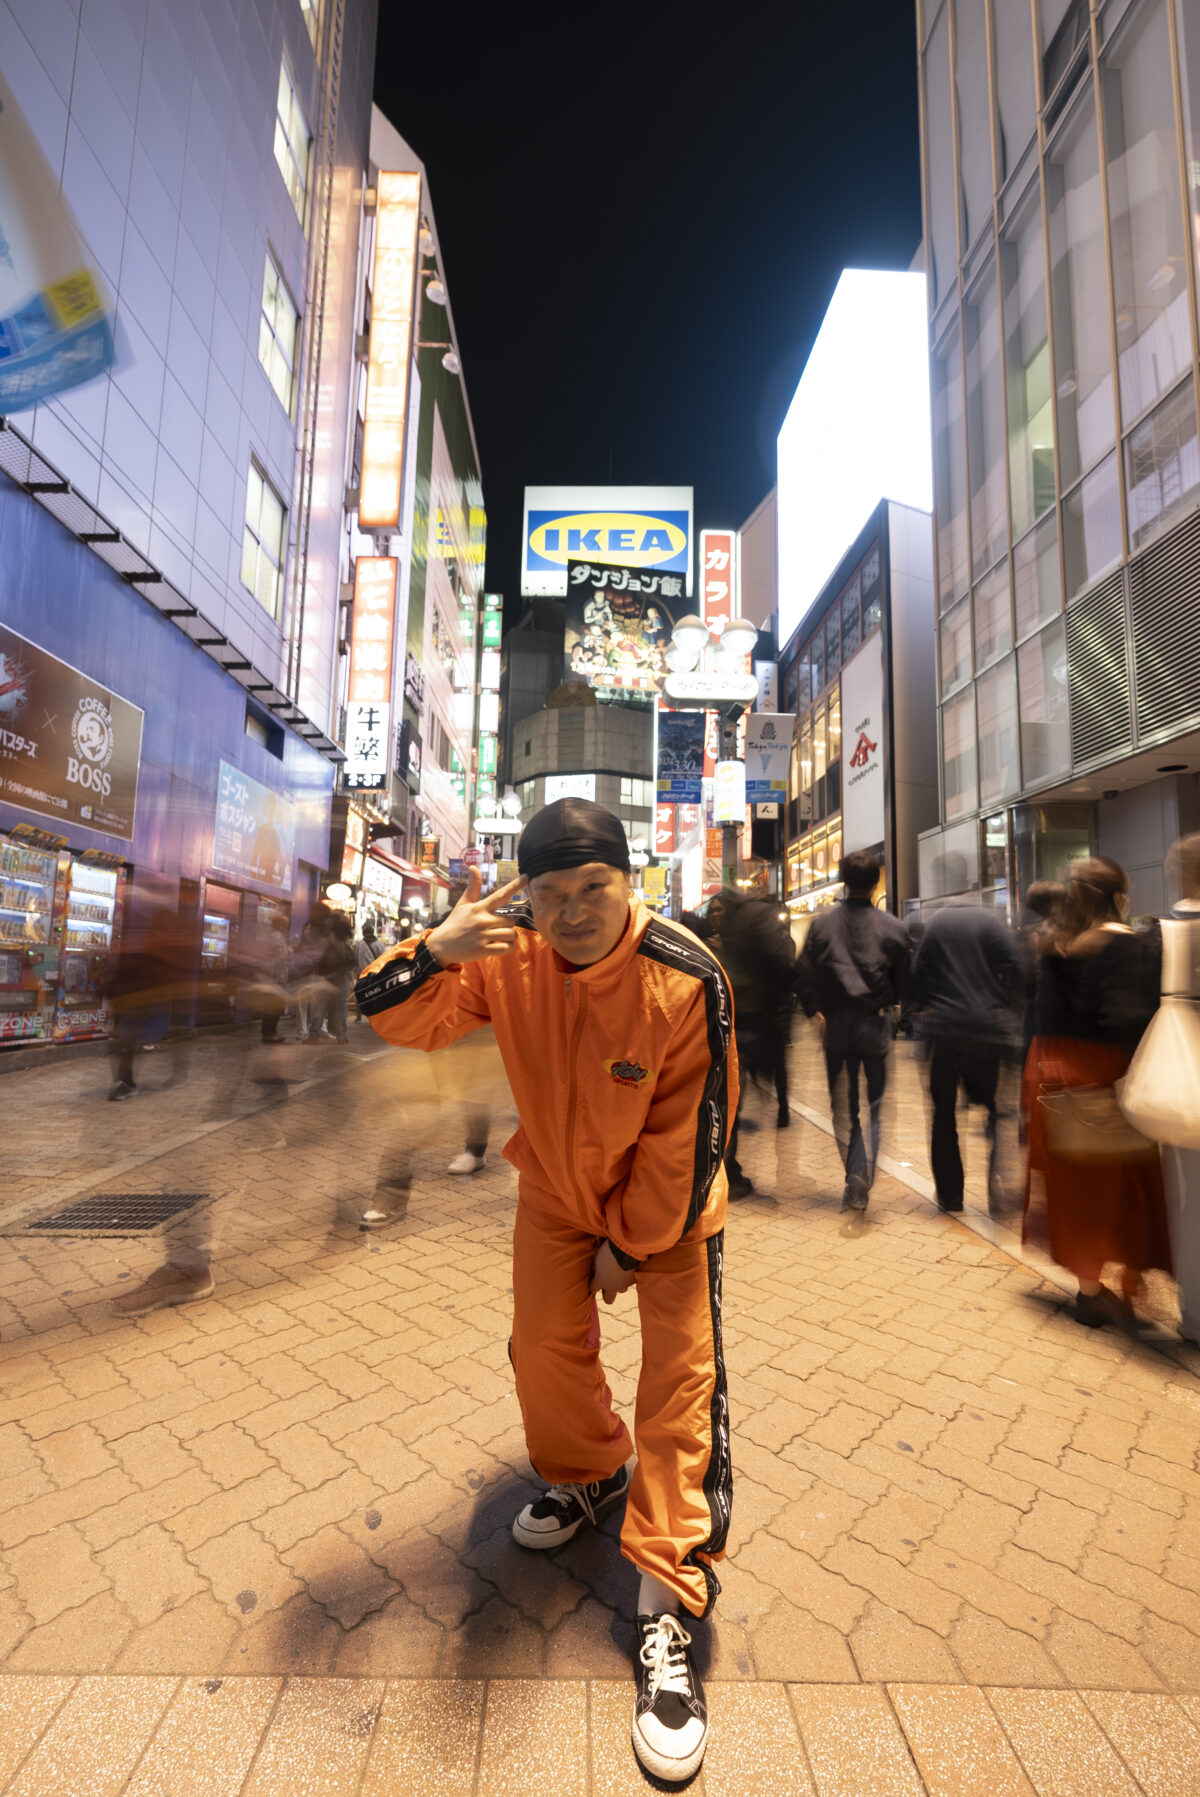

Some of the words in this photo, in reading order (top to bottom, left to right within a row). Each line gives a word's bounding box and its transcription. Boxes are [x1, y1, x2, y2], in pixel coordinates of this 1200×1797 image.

[544, 529, 674, 551] IKEA
[570, 564, 682, 598] ダンジョン飯
[78, 697, 113, 725] COFFEE
[354, 707, 381, 761] 牛繁
[66, 756, 112, 796] BOSS
[221, 775, 249, 805] ゴースト
[219, 801, 256, 833] ボスジャン
[650, 935, 691, 956] SPORT
[708, 1099, 720, 1155] FUBU
[717, 1467, 728, 1518] SPORT
